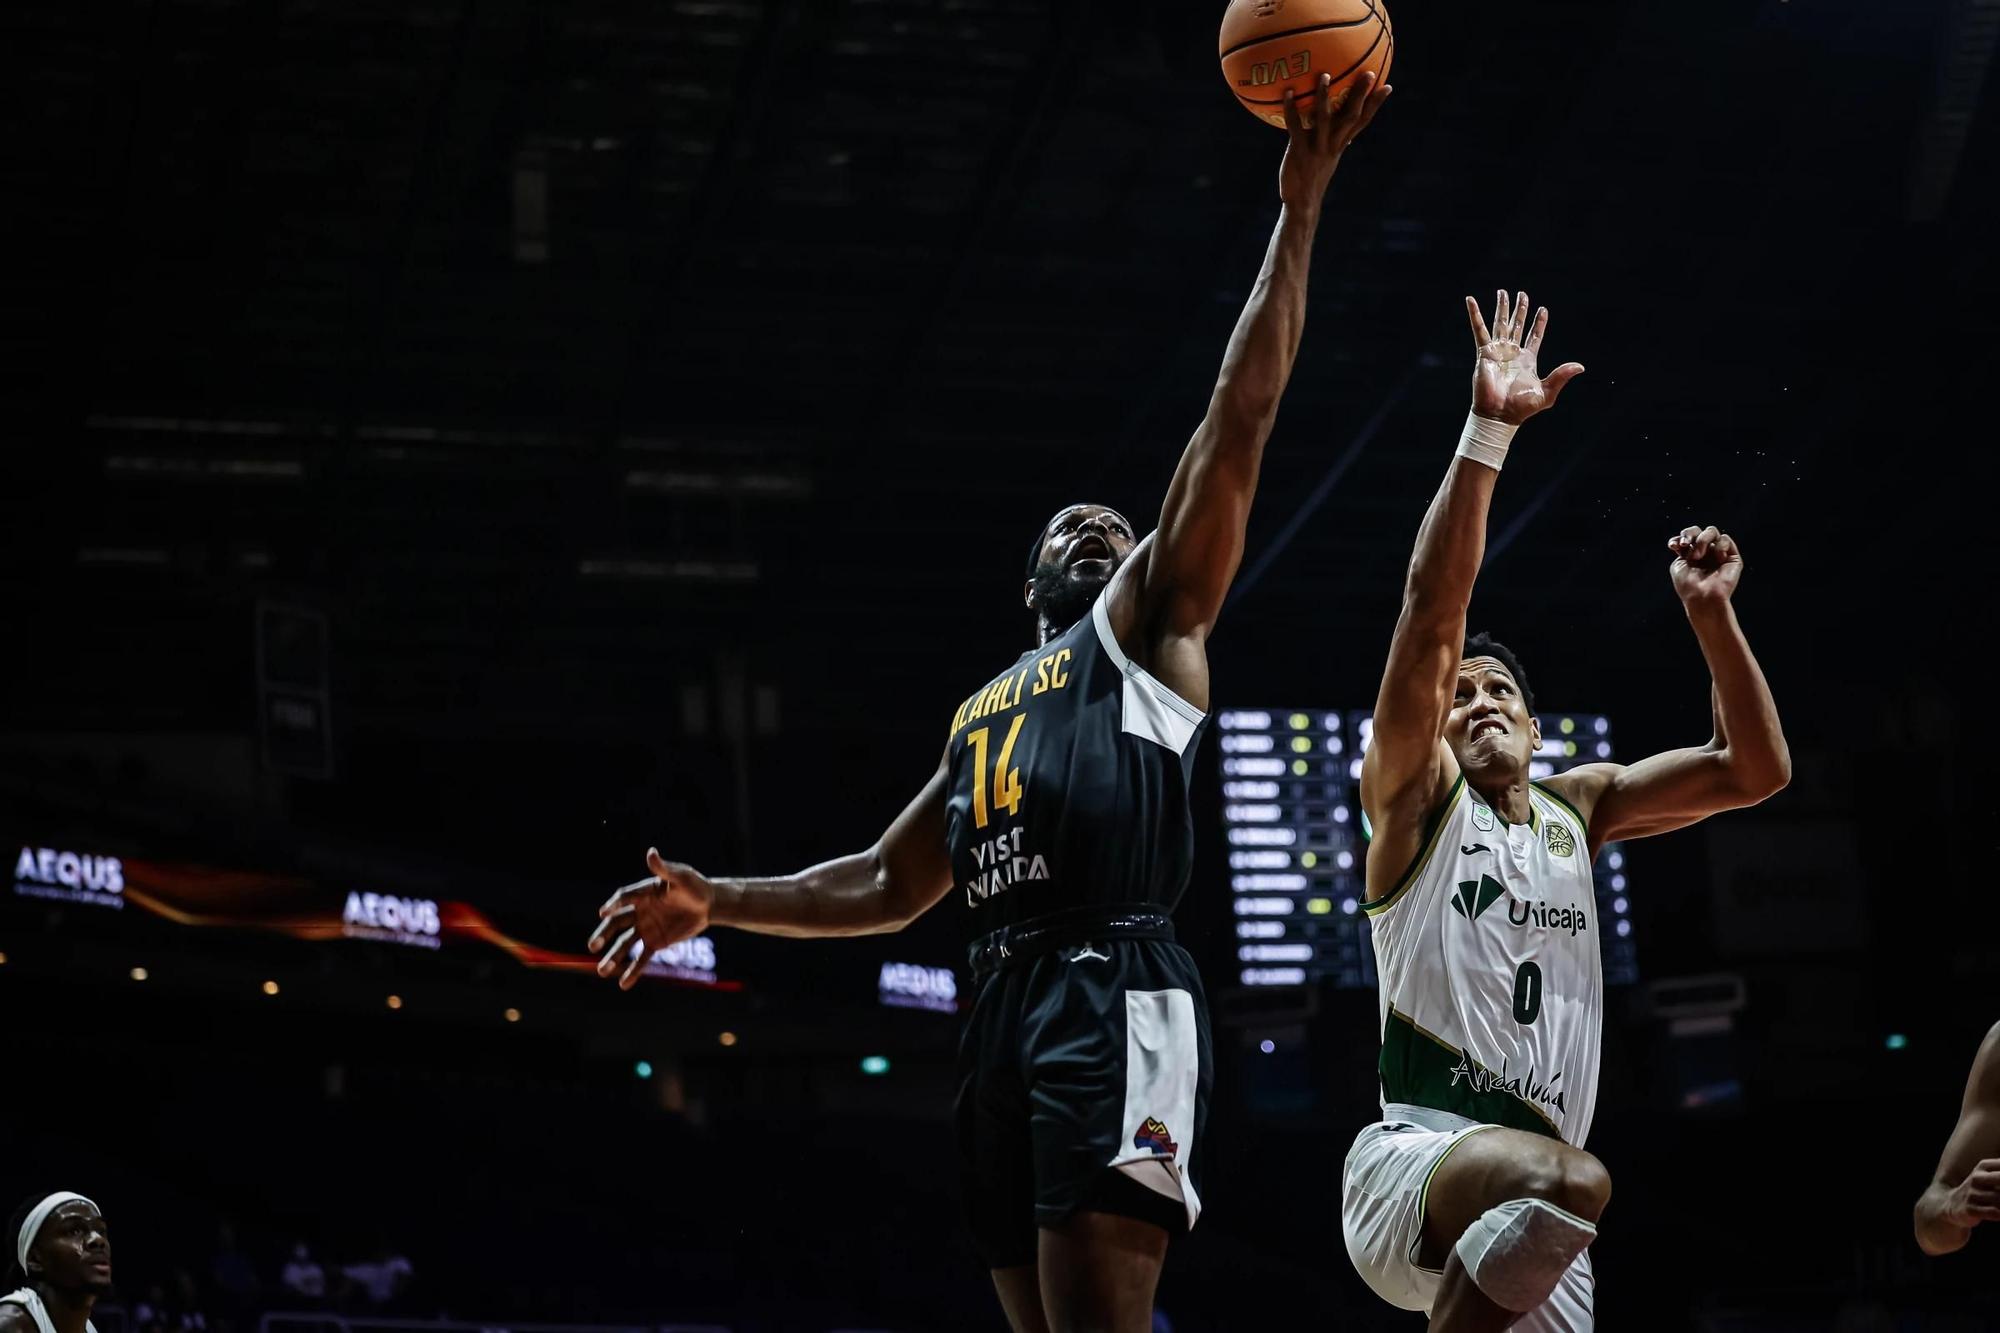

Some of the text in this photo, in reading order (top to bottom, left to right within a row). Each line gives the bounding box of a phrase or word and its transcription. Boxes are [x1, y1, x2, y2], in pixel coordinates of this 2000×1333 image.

[1250, 50, 1311, 87] EVO
[1032, 648, 1072, 696] SC
[967, 712, 1026, 829] 14
[1513, 961, 1543, 1026] 0
